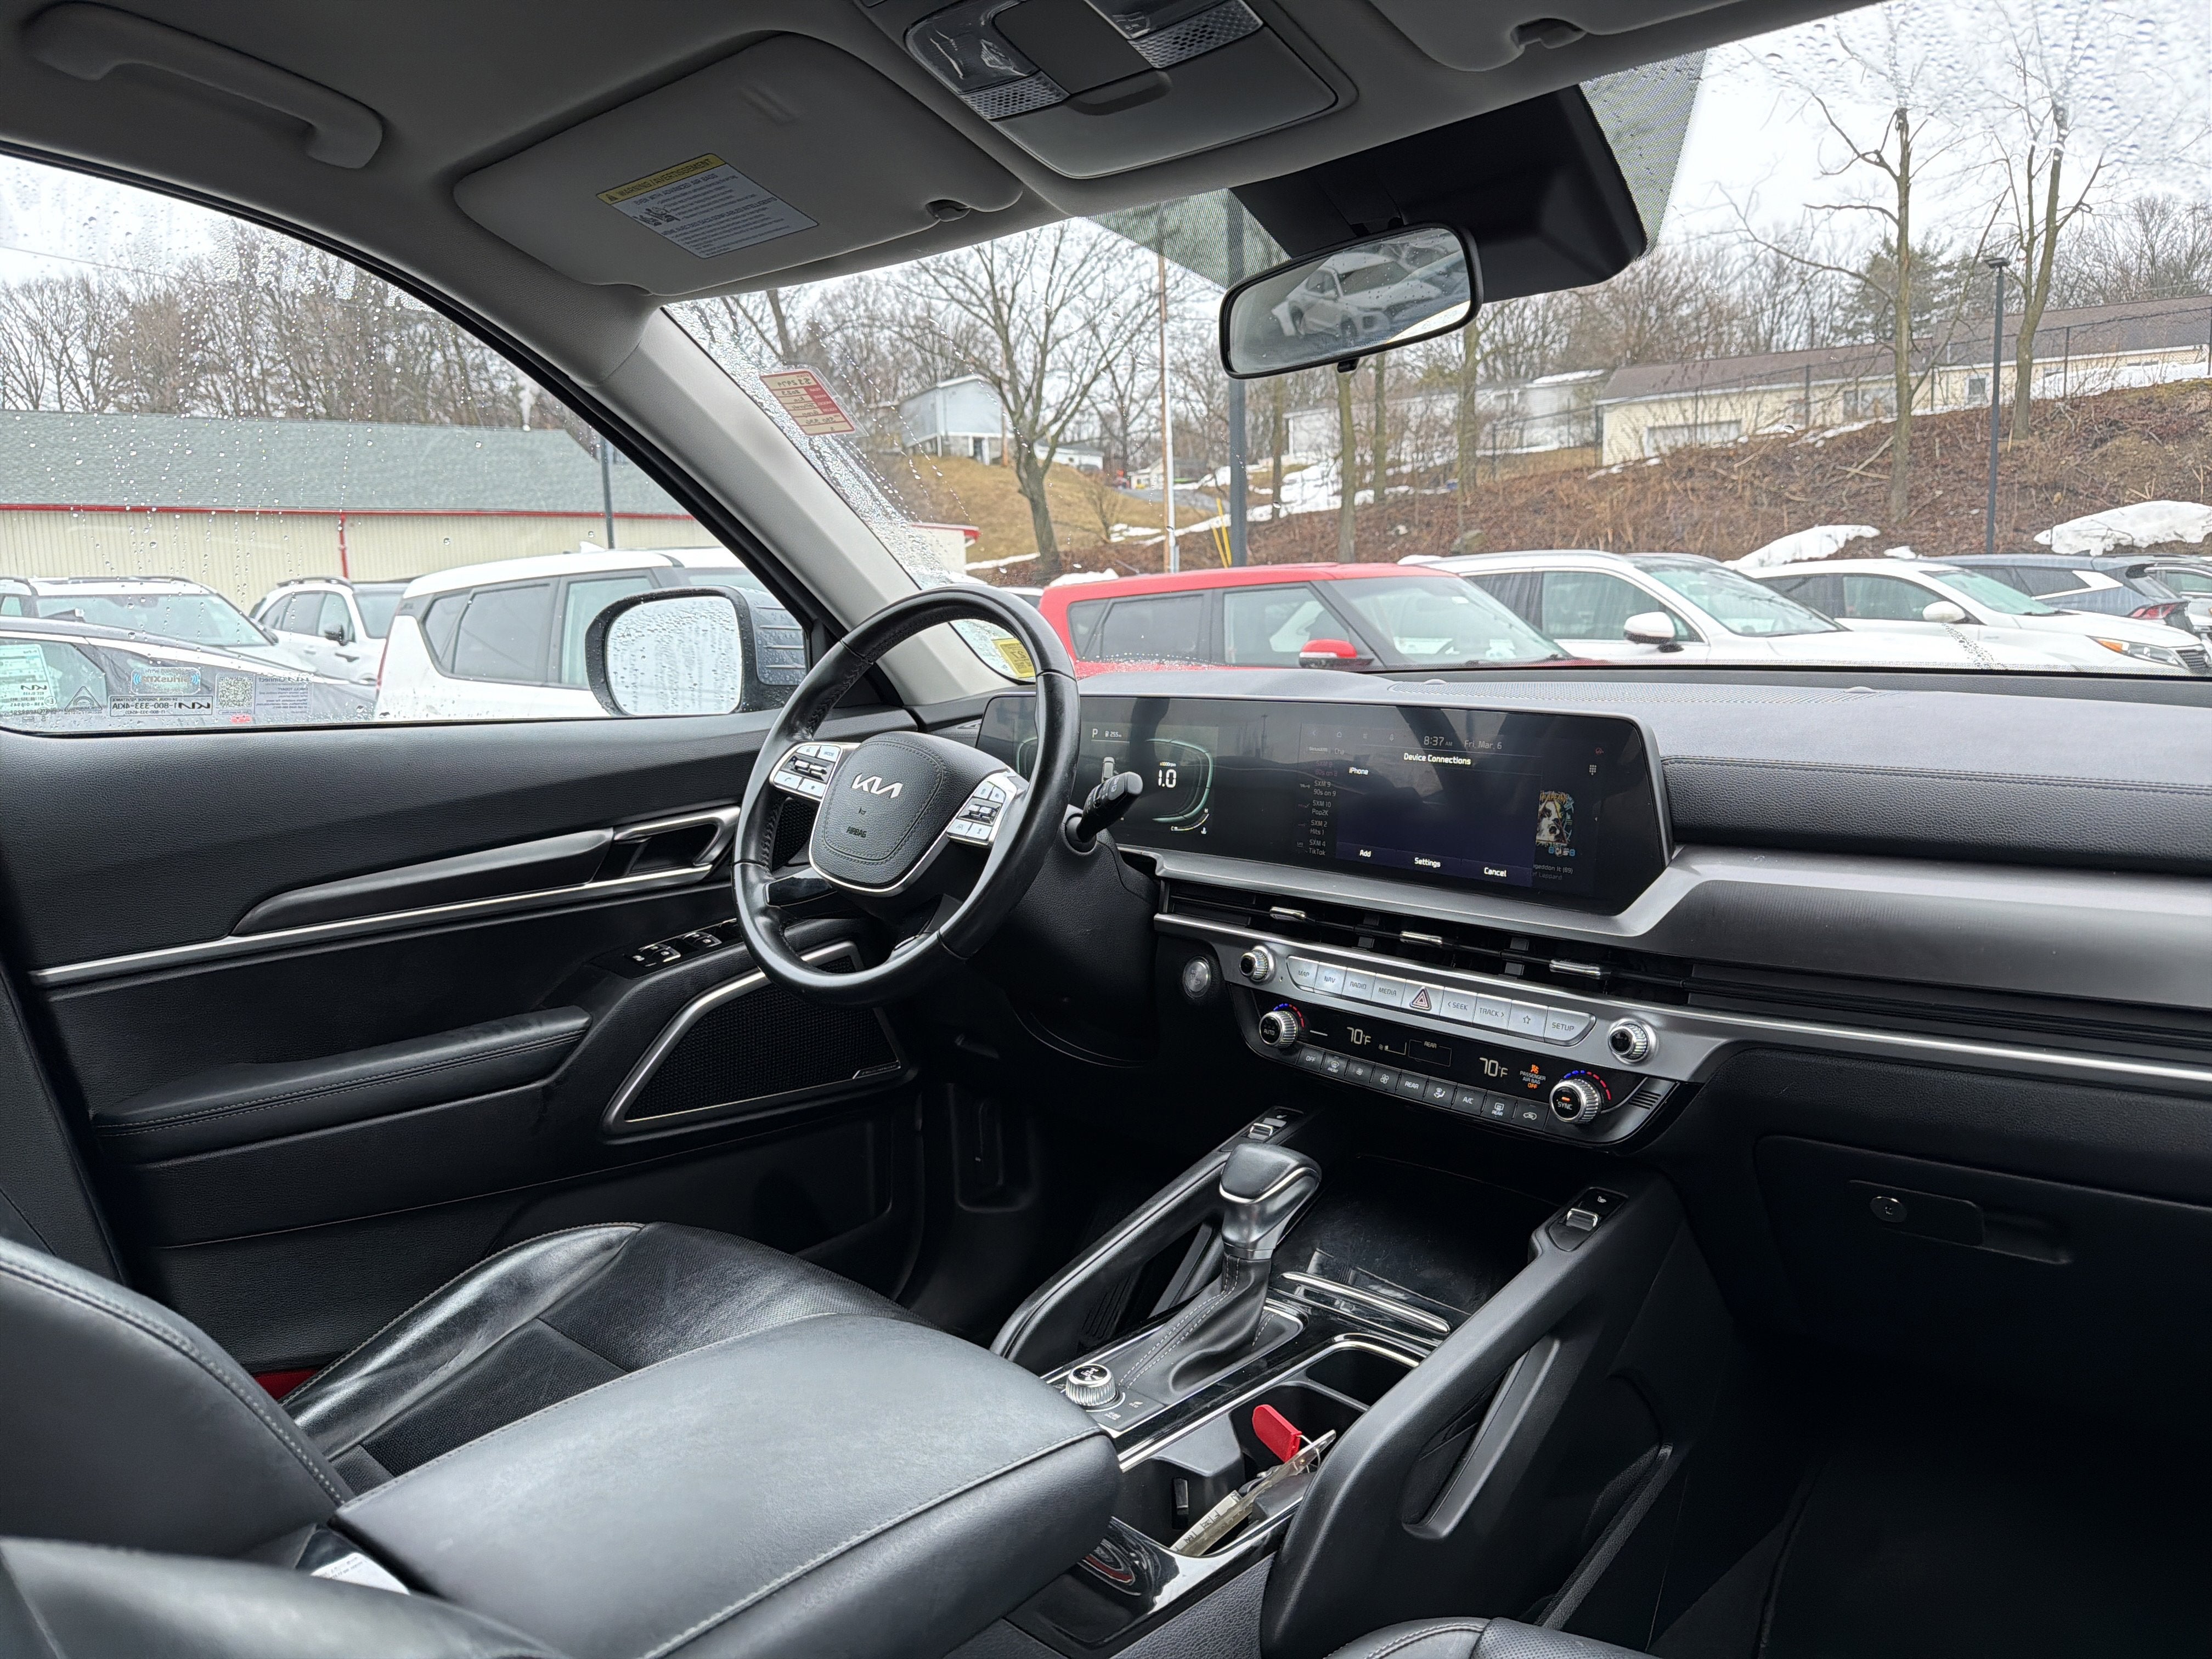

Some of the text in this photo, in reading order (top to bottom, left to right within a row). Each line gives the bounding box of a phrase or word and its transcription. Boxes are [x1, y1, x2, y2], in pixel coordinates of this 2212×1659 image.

[616, 182, 653, 196] WARNING
[1092, 727, 1099, 738] P
[1424, 736, 1444, 746] 8:37
[1464, 740, 1503, 750] Fri, Mar. 6
[1403, 752, 1471, 766] Device Connections
[1348, 766, 1369, 775] iPhone
[1158, 768, 1177, 788] 1.0
[851, 772, 904, 799] KIA
[1311, 808, 1329, 816] Pop2K
[847, 826, 867, 838] AIRBAG
[1308, 847, 1326, 856] TikTok
[1359, 849, 1372, 857] Add
[1414, 857, 1441, 869] Settings
[1483, 867, 1507, 877] Cancel
[1539, 872, 1563, 881] Leppard
[1349, 981, 1367, 990] RADIO
[1378, 987, 1397, 997] MEDIA
[1452, 1001, 1469, 1011] SEEK
[1479, 1007, 1499, 1017] TRACK
[1551, 1022, 1575, 1032] SETUP
[1423, 1041, 1437, 1049] REAR
[1520, 1070, 1546, 1081] PASSENGER
[1404, 1080, 1419, 1090] REAR
[1462, 1096, 1475, 1105] A/C
[1557, 1101, 1573, 1110] SYNC
